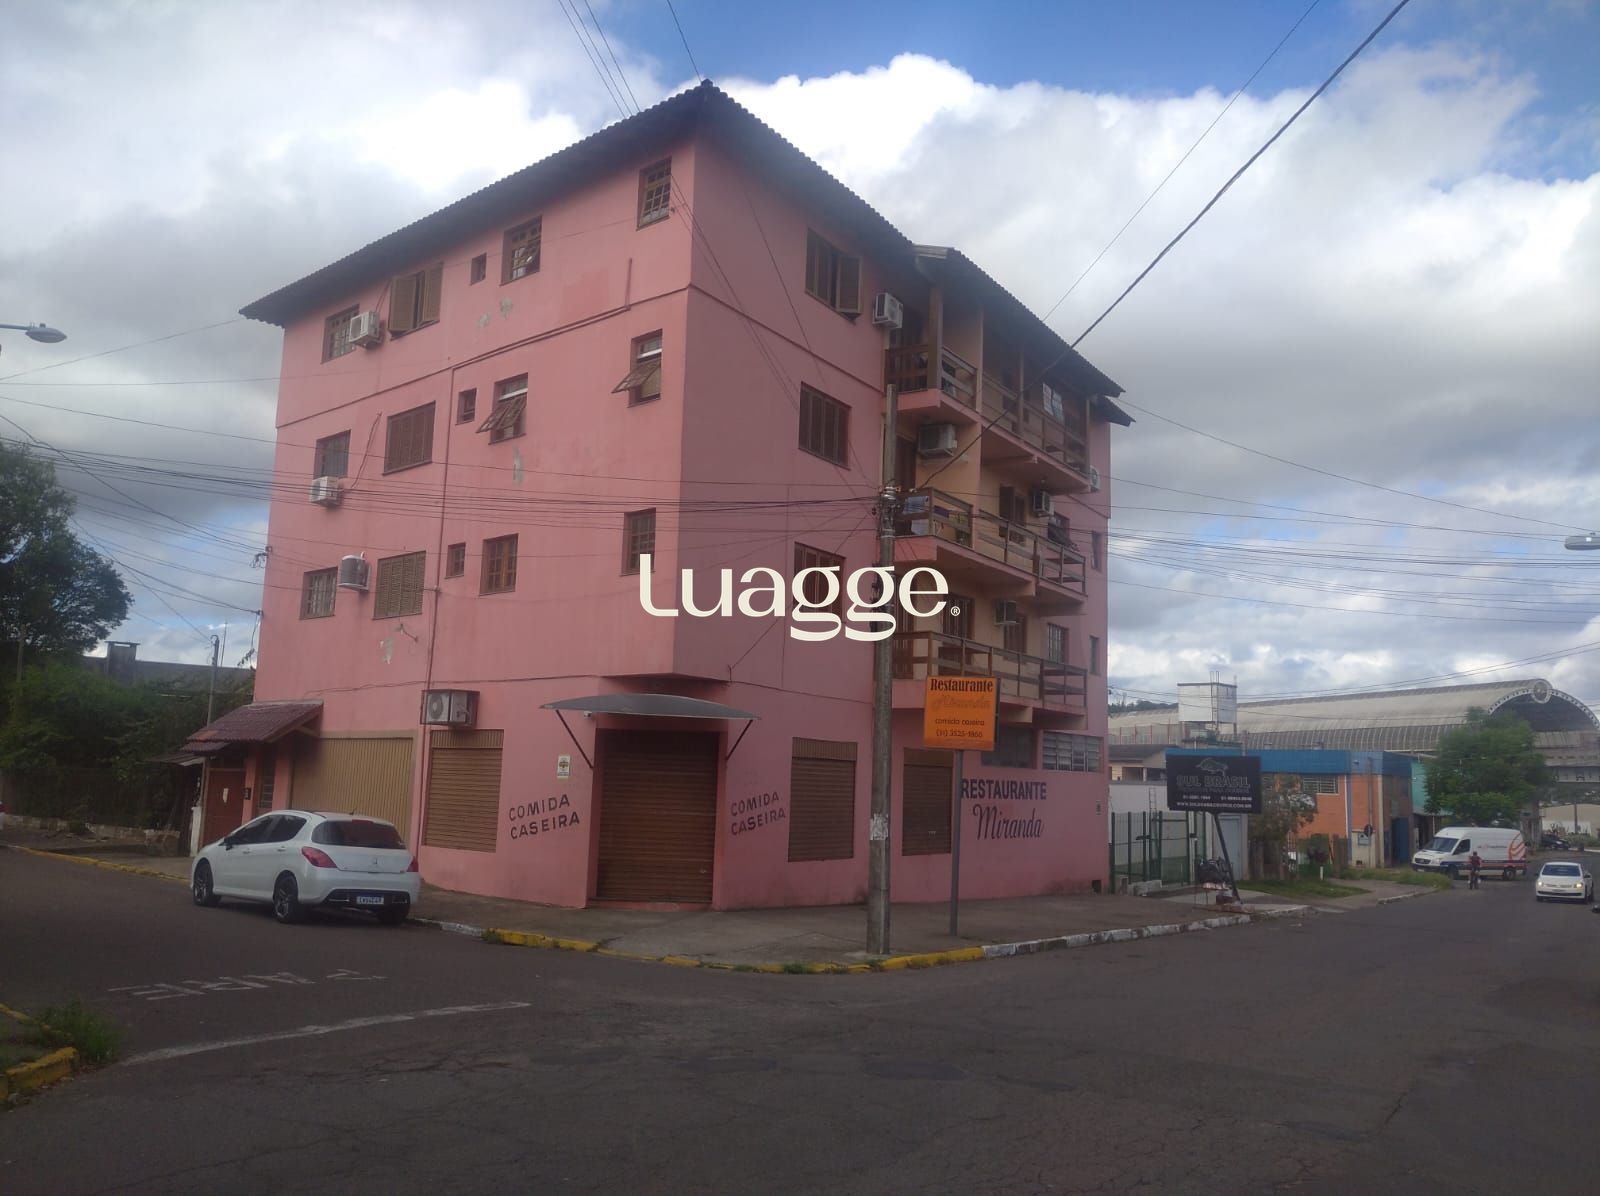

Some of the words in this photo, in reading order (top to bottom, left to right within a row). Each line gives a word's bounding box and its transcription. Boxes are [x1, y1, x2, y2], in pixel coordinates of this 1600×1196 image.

[930, 678, 993, 693] Restaurante
[961, 778, 1047, 800] RESTAURANTE
[509, 794, 571, 821] COMIDA
[731, 791, 780, 817] COMIDA
[510, 811, 580, 840] CASEIRA
[731, 807, 786, 836] CASEIRA
[972, 804, 1044, 840] Miranda
